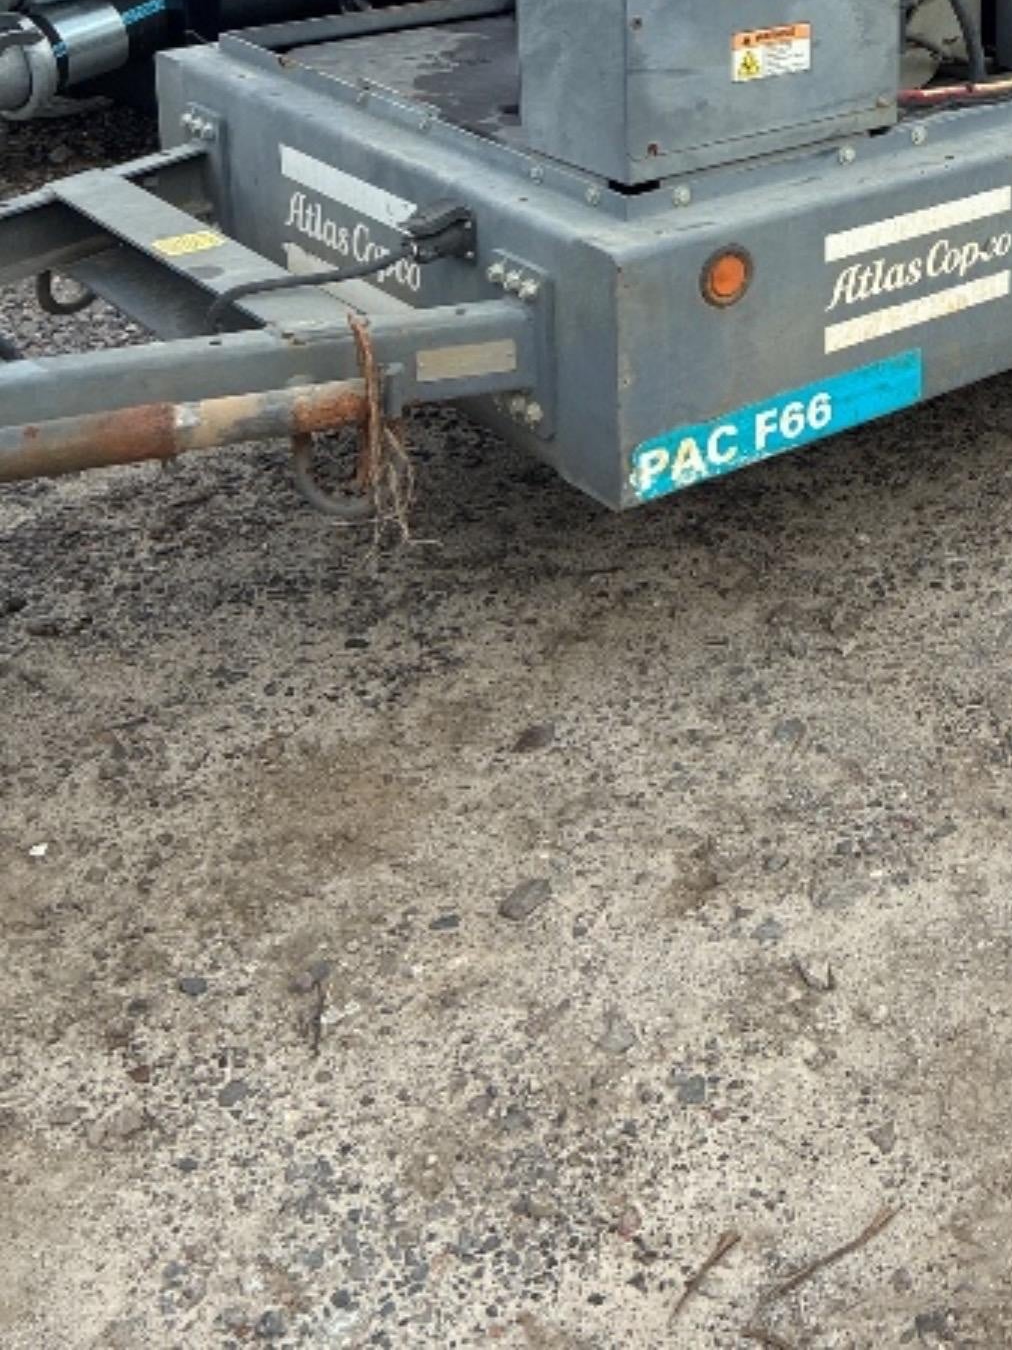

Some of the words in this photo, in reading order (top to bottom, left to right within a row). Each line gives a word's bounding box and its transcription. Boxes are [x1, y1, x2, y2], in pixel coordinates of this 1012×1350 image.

[284, 192, 349, 256] Atlas
[825, 257, 922, 312] Atlas
[927, 231, 1012, 276] Copco
[636, 425, 738, 491] PAC
[755, 392, 832, 451] F66
